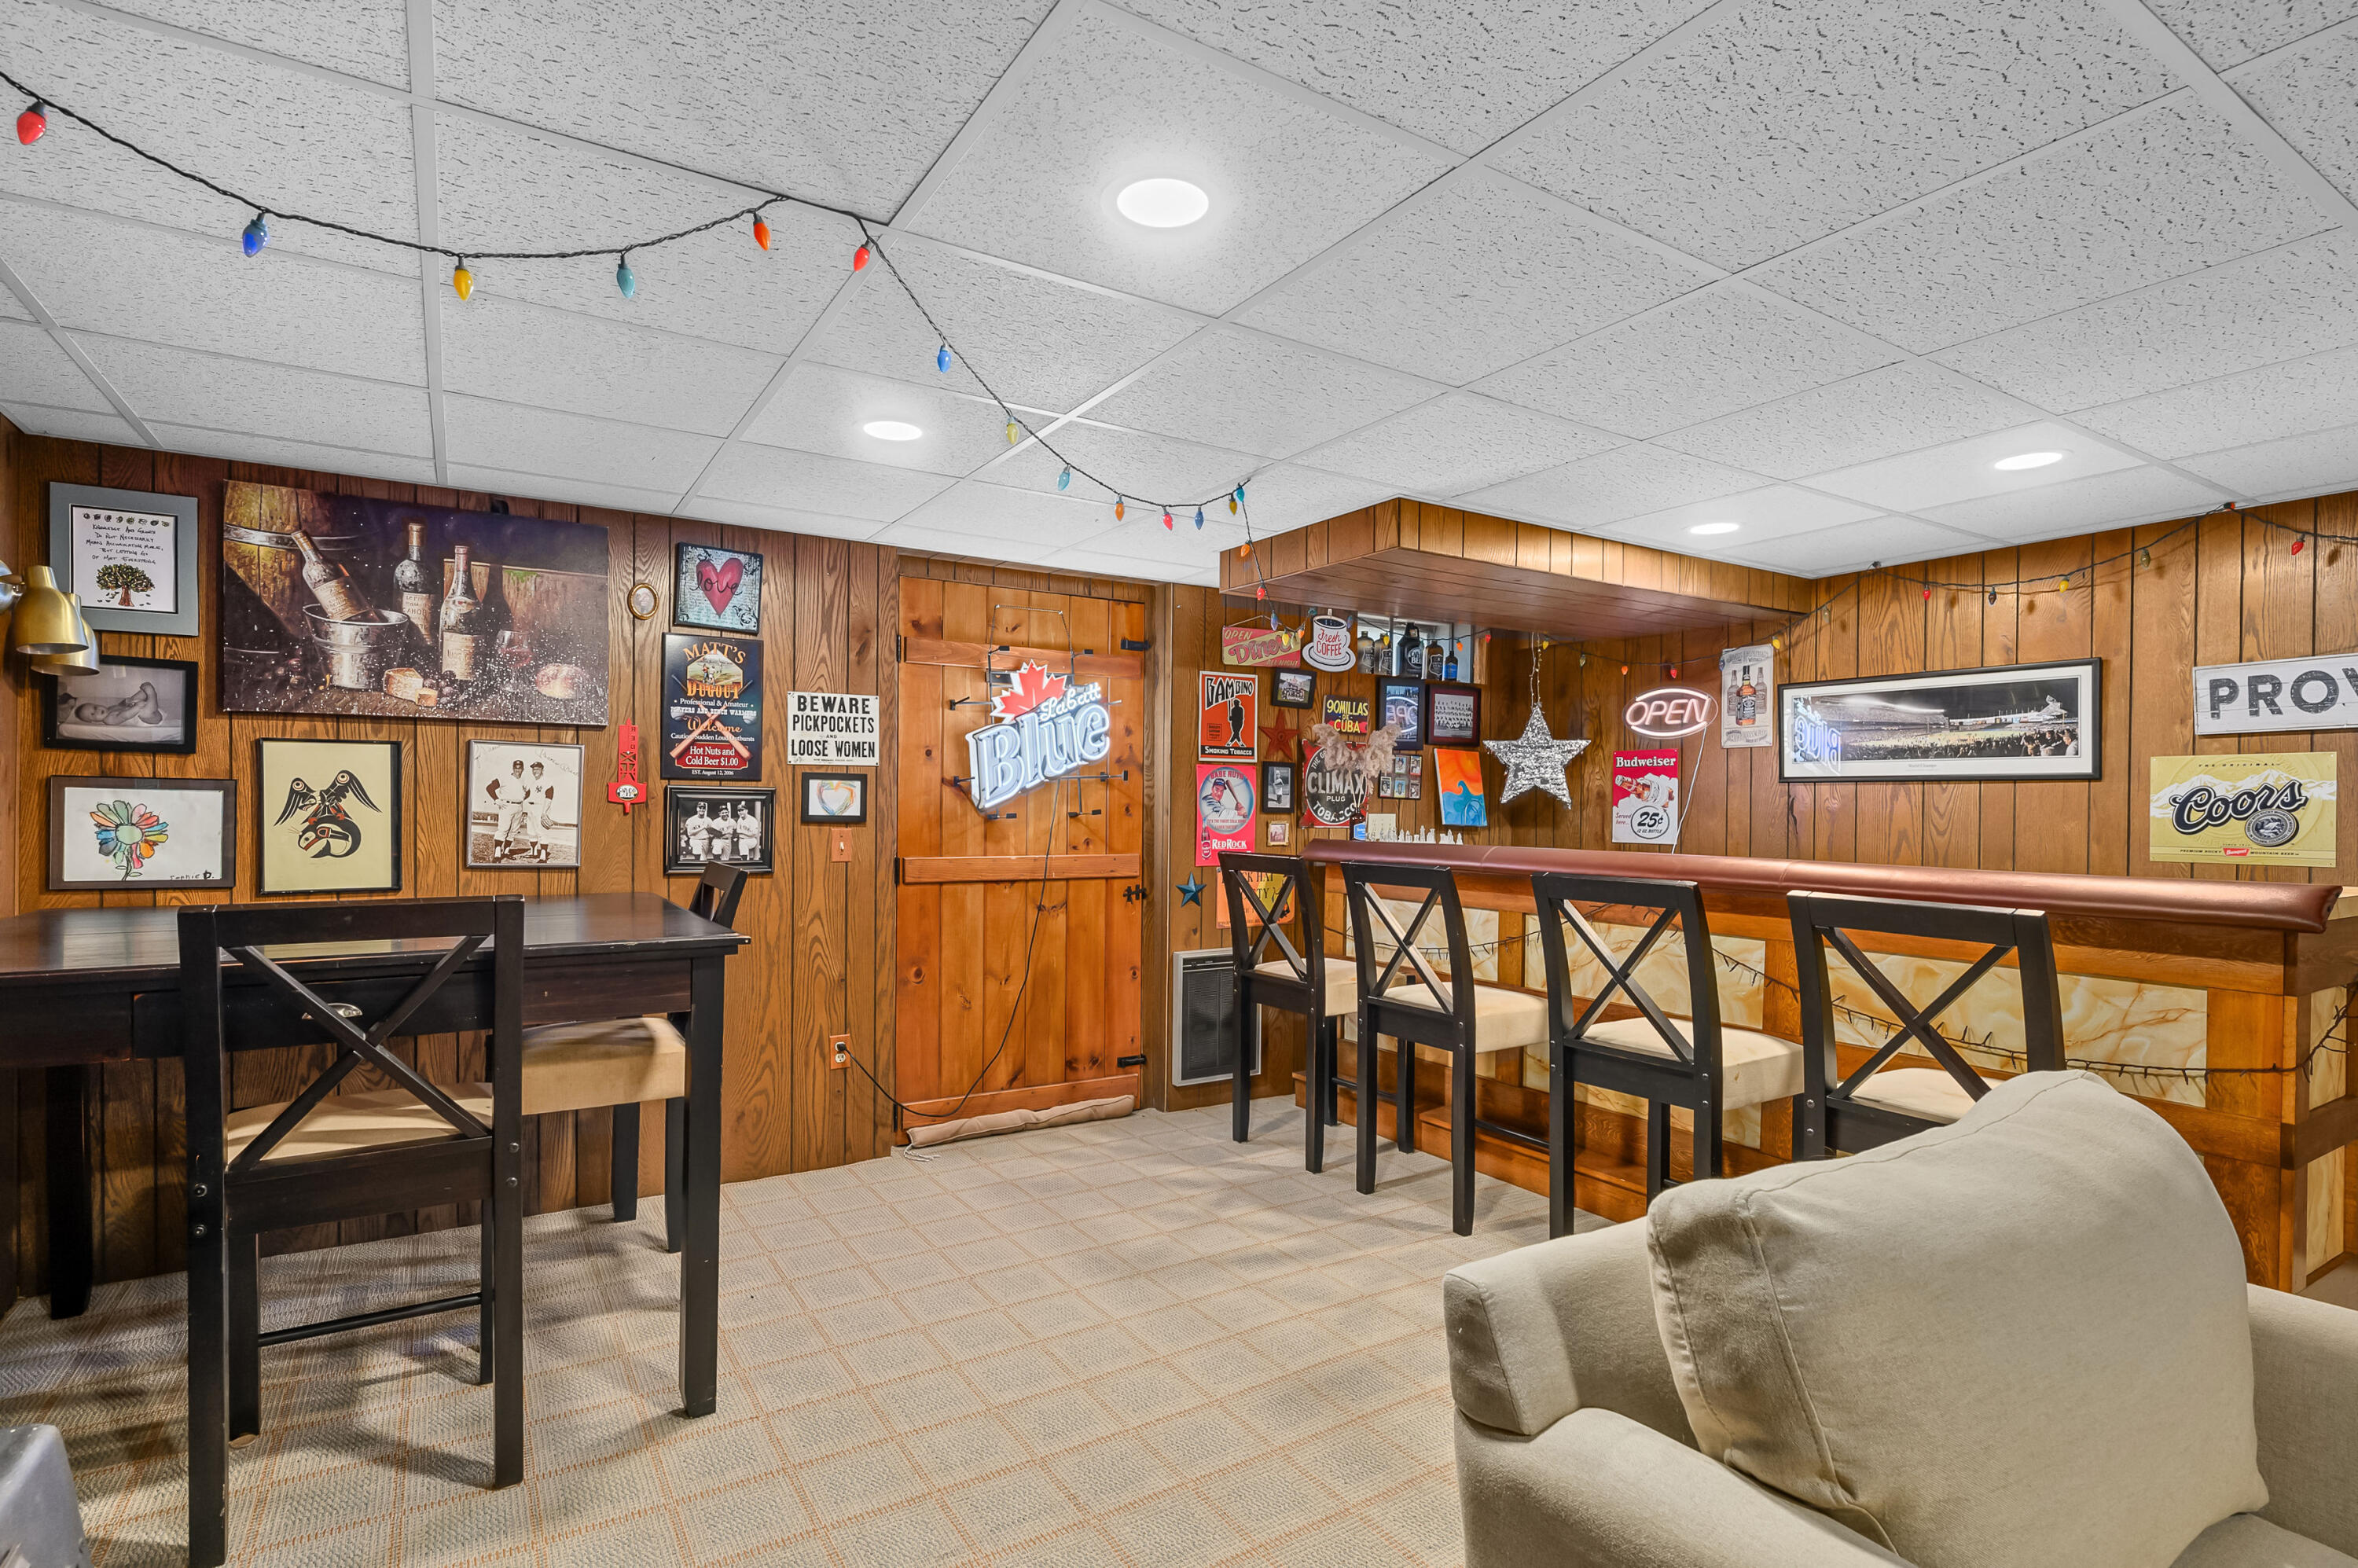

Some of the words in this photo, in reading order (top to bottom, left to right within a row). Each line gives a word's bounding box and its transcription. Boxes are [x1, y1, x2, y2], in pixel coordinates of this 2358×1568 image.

[689, 571, 743, 595] love
[1225, 629, 1253, 641] OPEN
[1317, 628, 1342, 643] Fresh
[682, 641, 747, 664] MATT'S
[1317, 641, 1342, 656] COFFEE
[687, 679, 742, 699] DUGOUT
[1205, 677, 1254, 710] BAMBINO
[680, 698, 715, 707] Professional
[797, 695, 870, 714] BEWARE
[1039, 681, 1102, 722] Labatt
[1625, 698, 1711, 725] OPEN
[792, 714, 874, 733] PICKPOCKETS
[1334, 719, 1361, 733] CUBA
[689, 746, 703, 755] Hot
[705, 747, 721, 755] Nuts
[792, 740, 828, 757] LOOSE
[835, 741, 875, 758] WOMEN
[974, 703, 1110, 809] Blue
[685, 756, 703, 765] Cold
[704, 756, 719, 766] Beer
[720, 758, 739, 766] $1.00
[1311, 757, 1320, 769] THE
[1616, 756, 1676, 768] Budweiser
[1307, 771, 1365, 795] CLIMAX
[2169, 780, 2309, 835] Coors
[1637, 811, 1663, 828] 25¢
